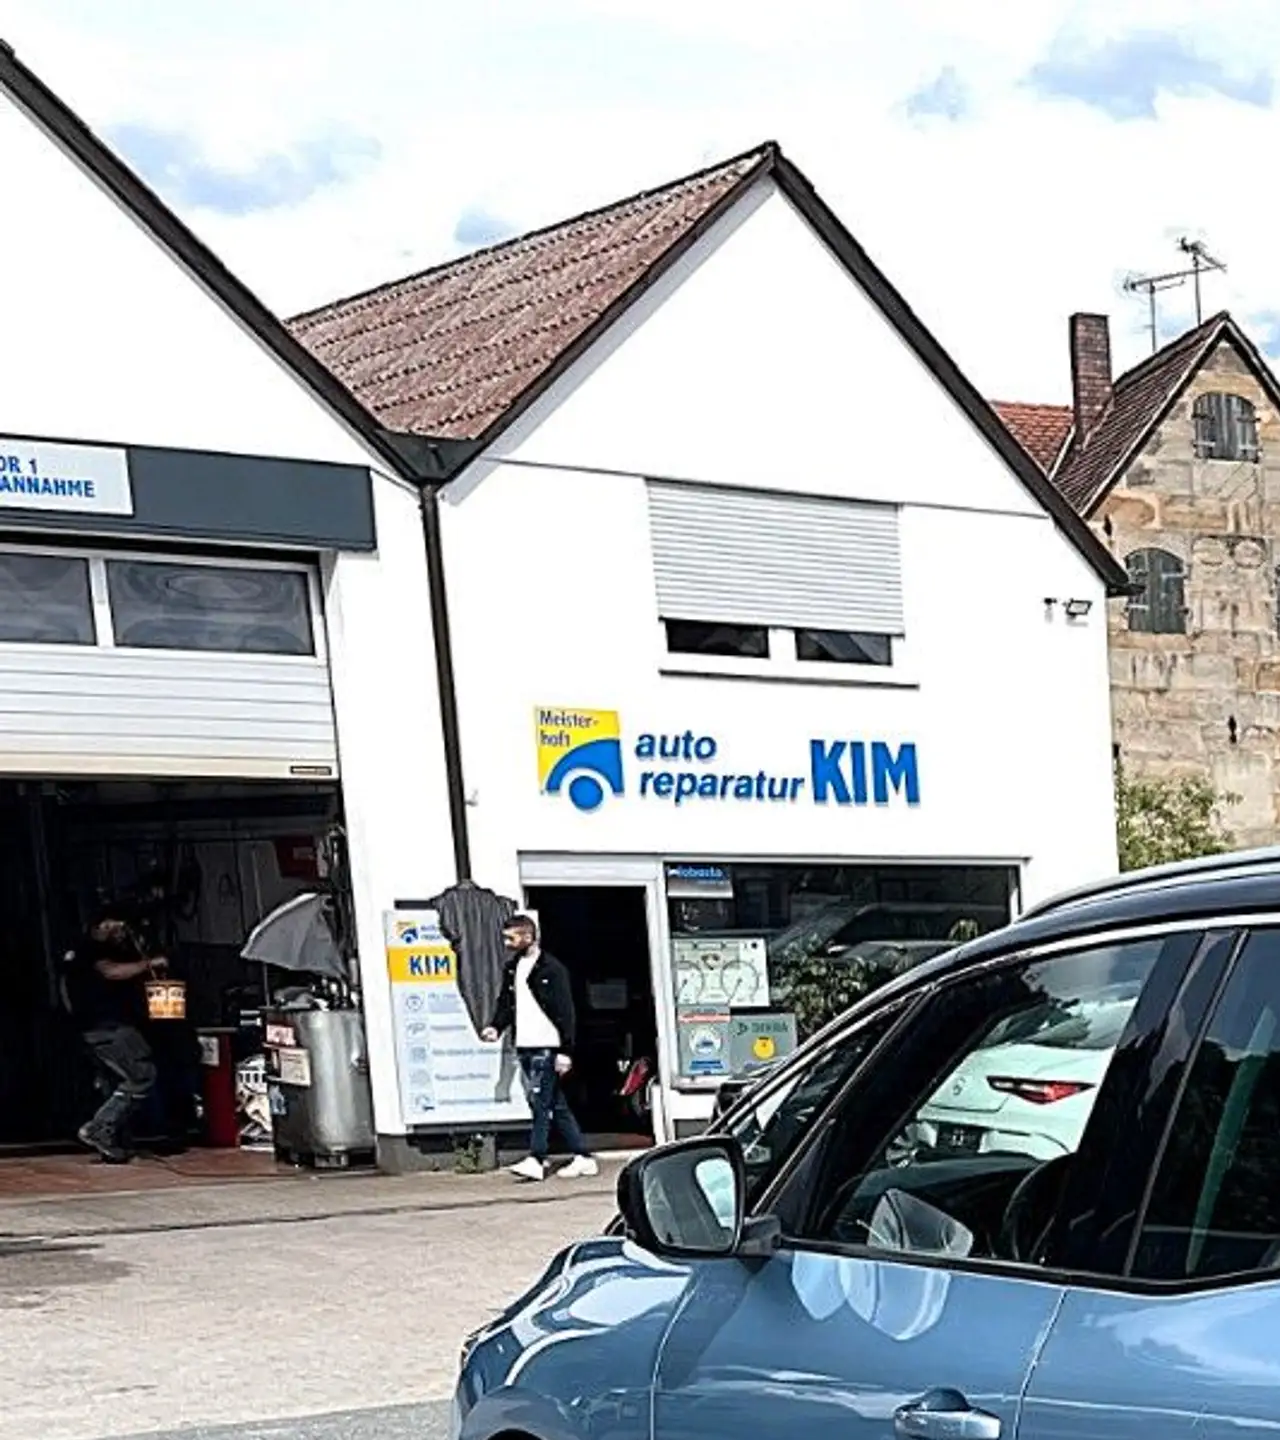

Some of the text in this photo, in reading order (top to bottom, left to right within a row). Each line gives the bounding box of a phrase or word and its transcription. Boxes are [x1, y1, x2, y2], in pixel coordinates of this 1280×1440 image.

[28, 458, 38, 475] 1
[539, 710, 600, 729] Meister-
[634, 729, 718, 760] auto
[640, 738, 921, 807] reparatur KIM
[409, 954, 451, 976] KIM
